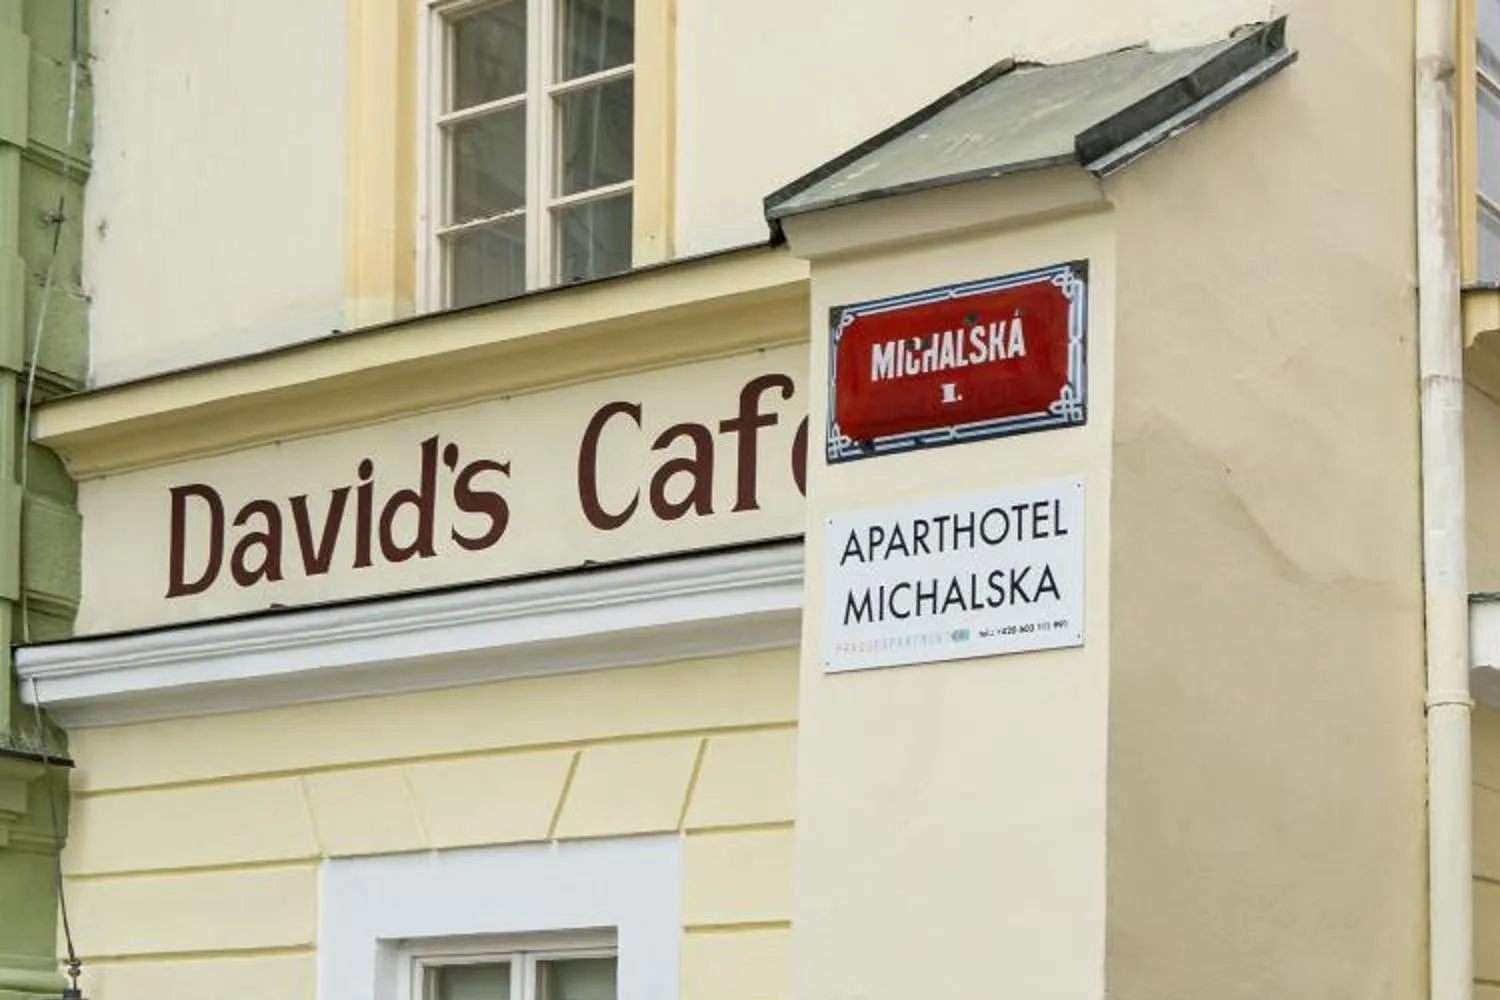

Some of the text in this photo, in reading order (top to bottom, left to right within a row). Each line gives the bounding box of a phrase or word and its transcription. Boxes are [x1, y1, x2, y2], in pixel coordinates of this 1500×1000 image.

[871, 308, 1027, 382] MICHALSKÁ
[165, 434, 511, 599] David's
[840, 499, 1067, 566] APARTHOTEL
[843, 563, 1061, 626] MICHALSKA
